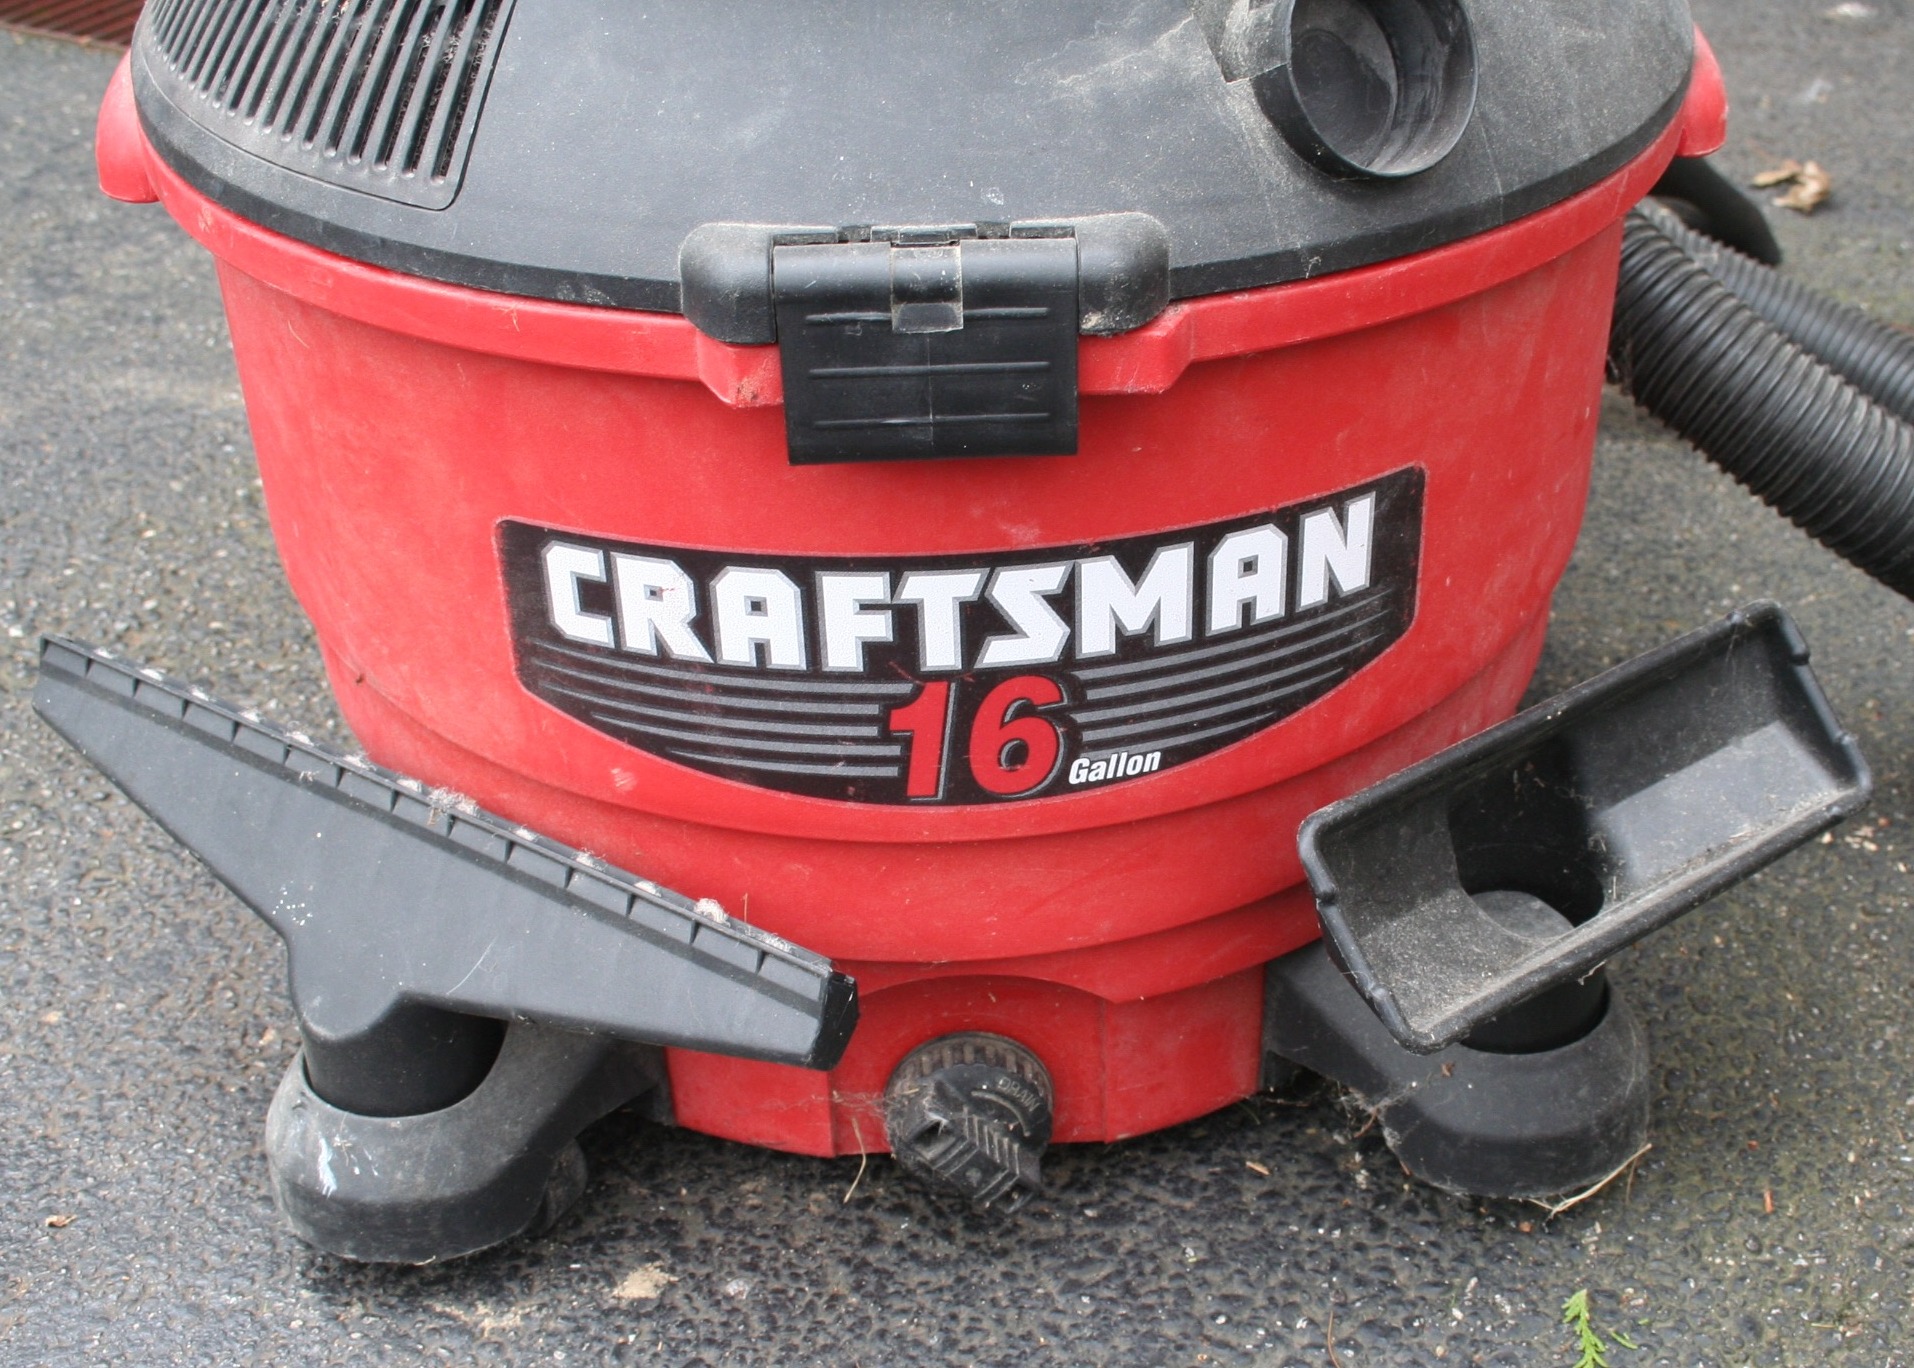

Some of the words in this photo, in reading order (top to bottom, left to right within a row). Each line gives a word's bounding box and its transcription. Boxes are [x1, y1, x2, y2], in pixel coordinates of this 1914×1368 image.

[541, 493, 1375, 672] CRAFTSMAN
[888, 675, 1068, 800] 16
[1070, 750, 1162, 785] Gallon
[997, 1076, 1041, 1112] DRAIN
